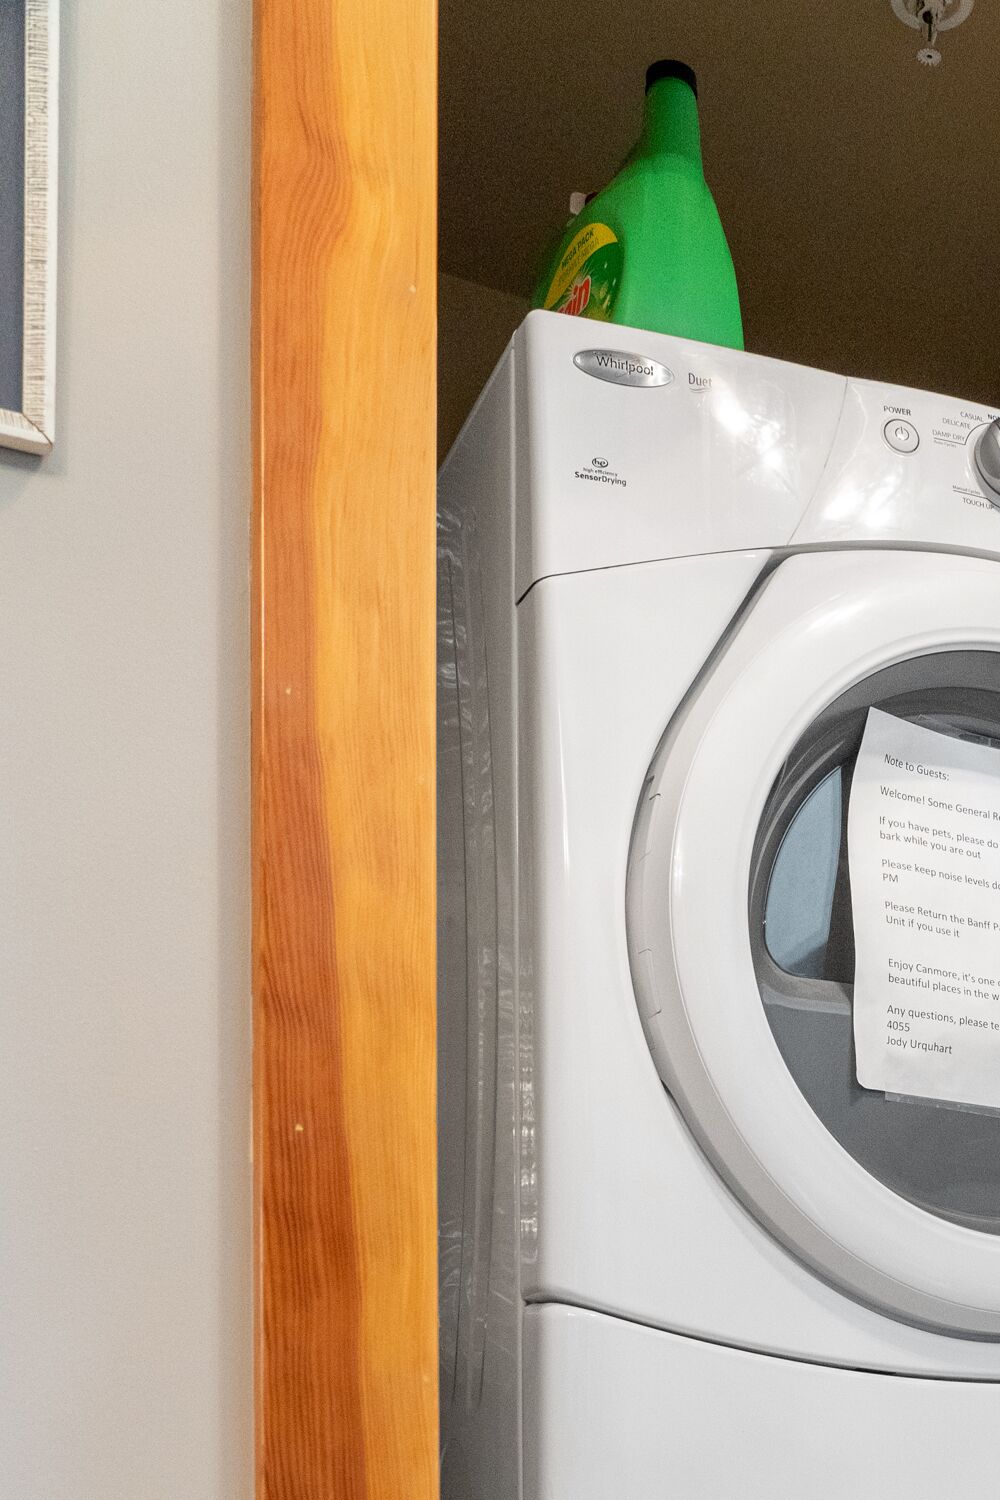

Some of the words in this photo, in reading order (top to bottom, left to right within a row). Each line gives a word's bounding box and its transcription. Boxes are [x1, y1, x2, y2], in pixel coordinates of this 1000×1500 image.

[577, 227, 595, 252] PACK
[595, 355, 654, 376] Whirlpool
[688, 372, 712, 388] Duet
[883, 405, 911, 416] POWER
[960, 411, 984, 422] CASUAL
[942, 418, 970, 429] DELICATE
[932, 429, 951, 438] DAMP
[953, 433, 965, 441] DRY
[575, 471, 627, 487] SensorDrying
[962, 497, 985, 508] TOUCH
[986, 502, 995, 510] UP
[884, 753, 904, 769] Note
[905, 762, 915, 773] to
[880, 785, 925, 805] Welcome!
[927, 797, 953, 812] Some
[955, 803, 990, 820] General
[879, 816, 886, 825] If
[888, 818, 906, 831] you
[908, 820, 930, 834] have
[932, 828, 954, 840] pets,
[956, 832, 985, 848] please
[987, 837, 999, 849] do
[879, 830, 901, 842] bark
[903, 834, 928, 847] while
[930, 840, 947, 853] you
[949, 846, 964, 856] are
[966, 849, 981, 859] out
[881, 859, 912, 872] Please
[914, 863, 937, 878] keep
[938, 870, 962, 884] noise
[965, 875, 990, 888] levels
[882, 873, 899, 883] PM
[885, 901, 915, 914] Please
[917, 906, 948, 921] Return
[950, 914, 965, 925] the
[967, 917, 990, 931] Banff
[886, 915, 905, 927] Unit
[908, 919, 915, 928] if
[916, 923, 933, 934] you
[935, 926, 951, 936] use
[953, 928, 960, 938] it
[888, 958, 913, 972] Enjoy
[916, 963, 960, 981] Canmore,
[962, 972, 976, 983] it's
[977, 977, 995, 987] one
[888, 973, 930, 989] beautiful
[932, 981, 961, 995] places
[963, 986, 972, 996] in
[974, 989, 990, 1000] the
[887, 1005, 906, 1018] Any
[908, 1009, 957, 1025] questions,
[959, 1015, 989, 1030] please
[887, 1020, 910, 1032] 4055
[886, 1036, 908, 1049] Jody
[910, 1039, 952, 1055] Urquhart
